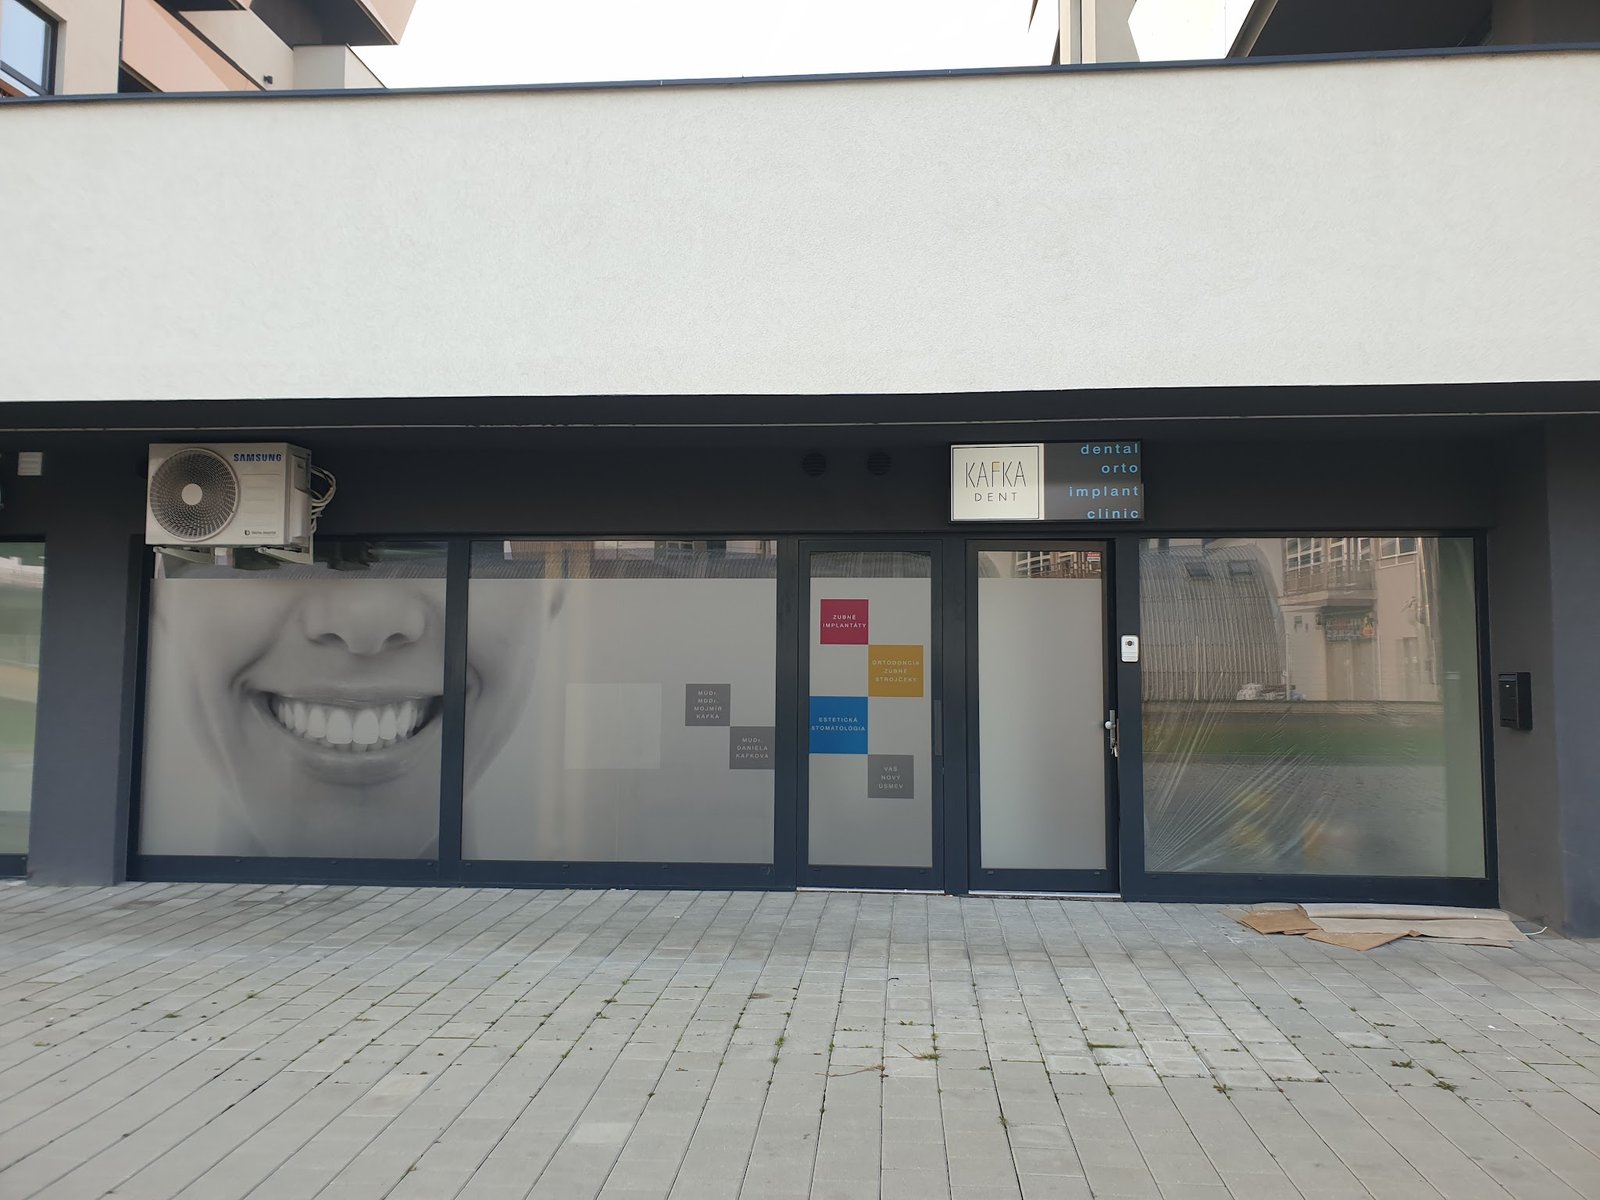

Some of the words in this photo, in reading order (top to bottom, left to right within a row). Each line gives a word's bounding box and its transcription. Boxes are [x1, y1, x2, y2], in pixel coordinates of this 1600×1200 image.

[1080, 443, 1139, 455] dental
[233, 453, 282, 462] SAMSUNG
[1101, 463, 1139, 474] orto
[965, 461, 1027, 488] KAFKA
[974, 492, 1018, 502] DENT
[1069, 486, 1139, 499] implant
[1087, 509, 1139, 520] clinic
